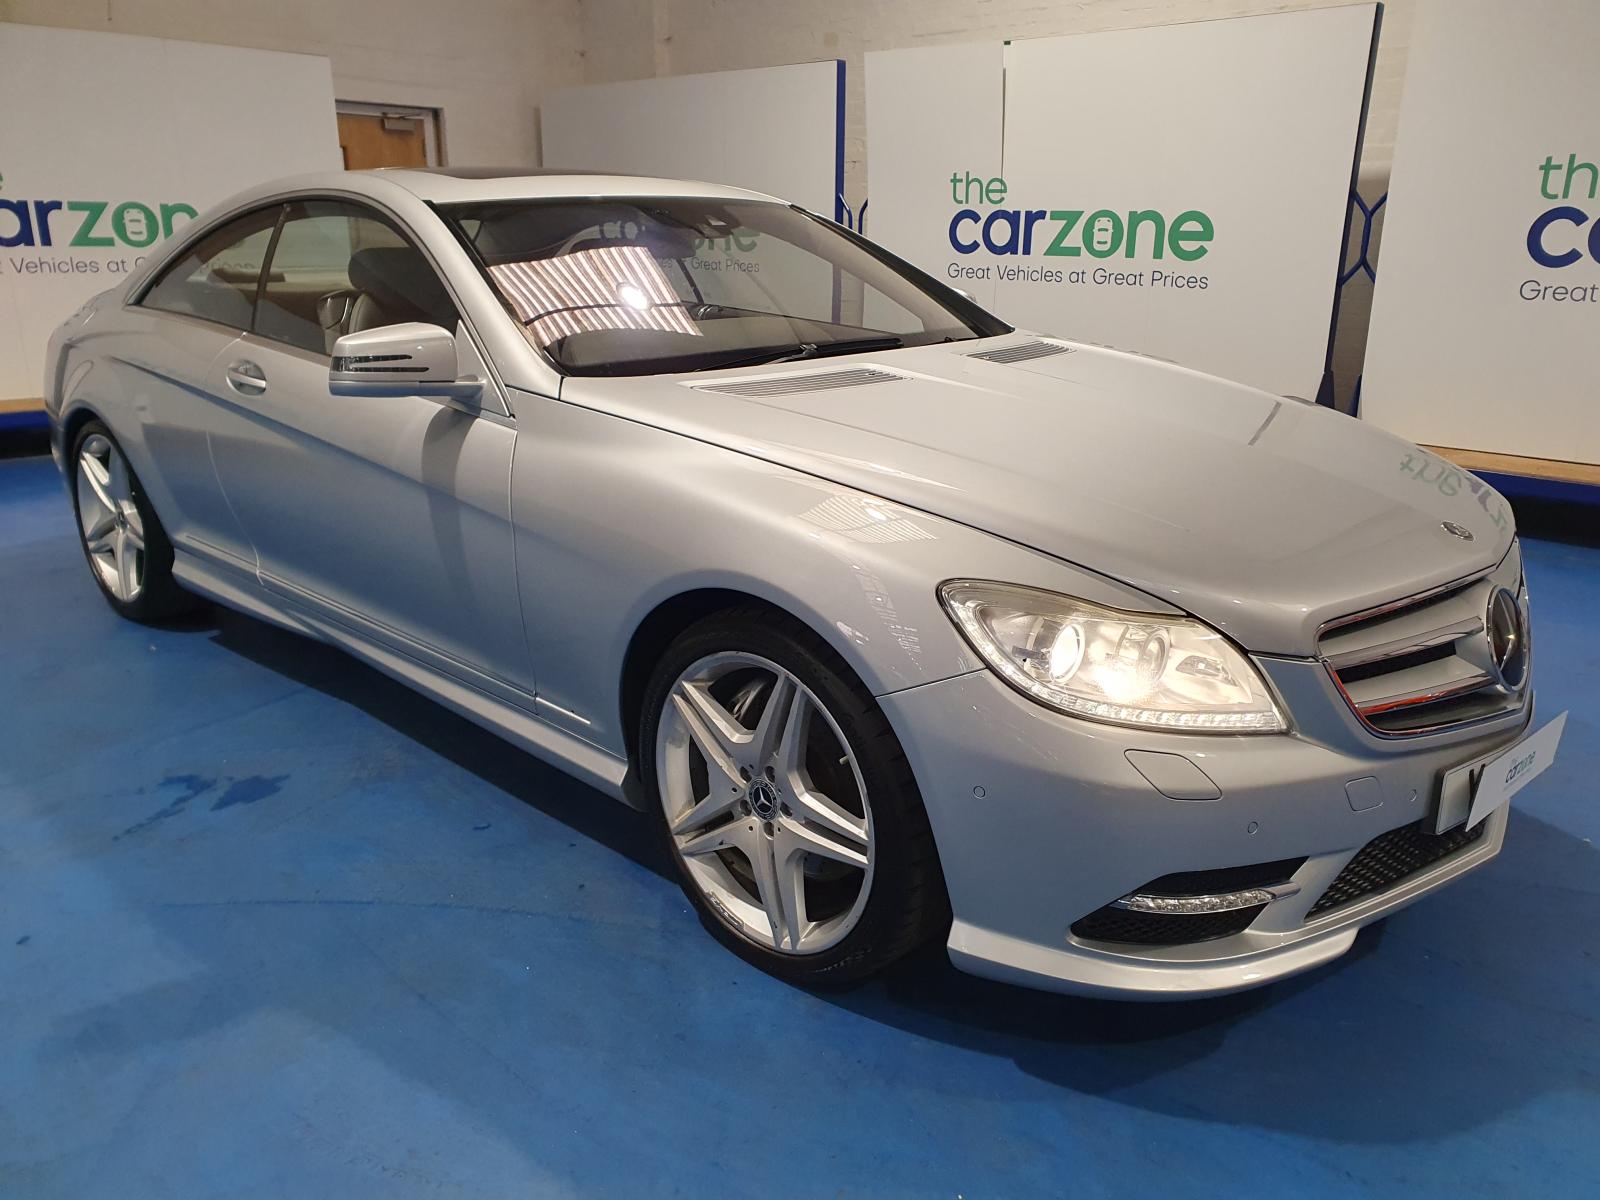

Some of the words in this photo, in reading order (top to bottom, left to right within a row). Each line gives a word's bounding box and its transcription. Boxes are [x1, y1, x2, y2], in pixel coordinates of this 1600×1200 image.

[950, 171, 1007, 205] the
[948, 208, 1214, 261] carzone
[9, 257, 100, 275] Vehicles
[106, 258, 128, 274] at
[947, 262, 991, 280] Great
[996, 264, 1063, 283] Vehicles
[1068, 269, 1087, 285] at
[1092, 267, 1144, 287] Great
[1151, 270, 1209, 290] Prices
[1519, 279, 1599, 303] Great
